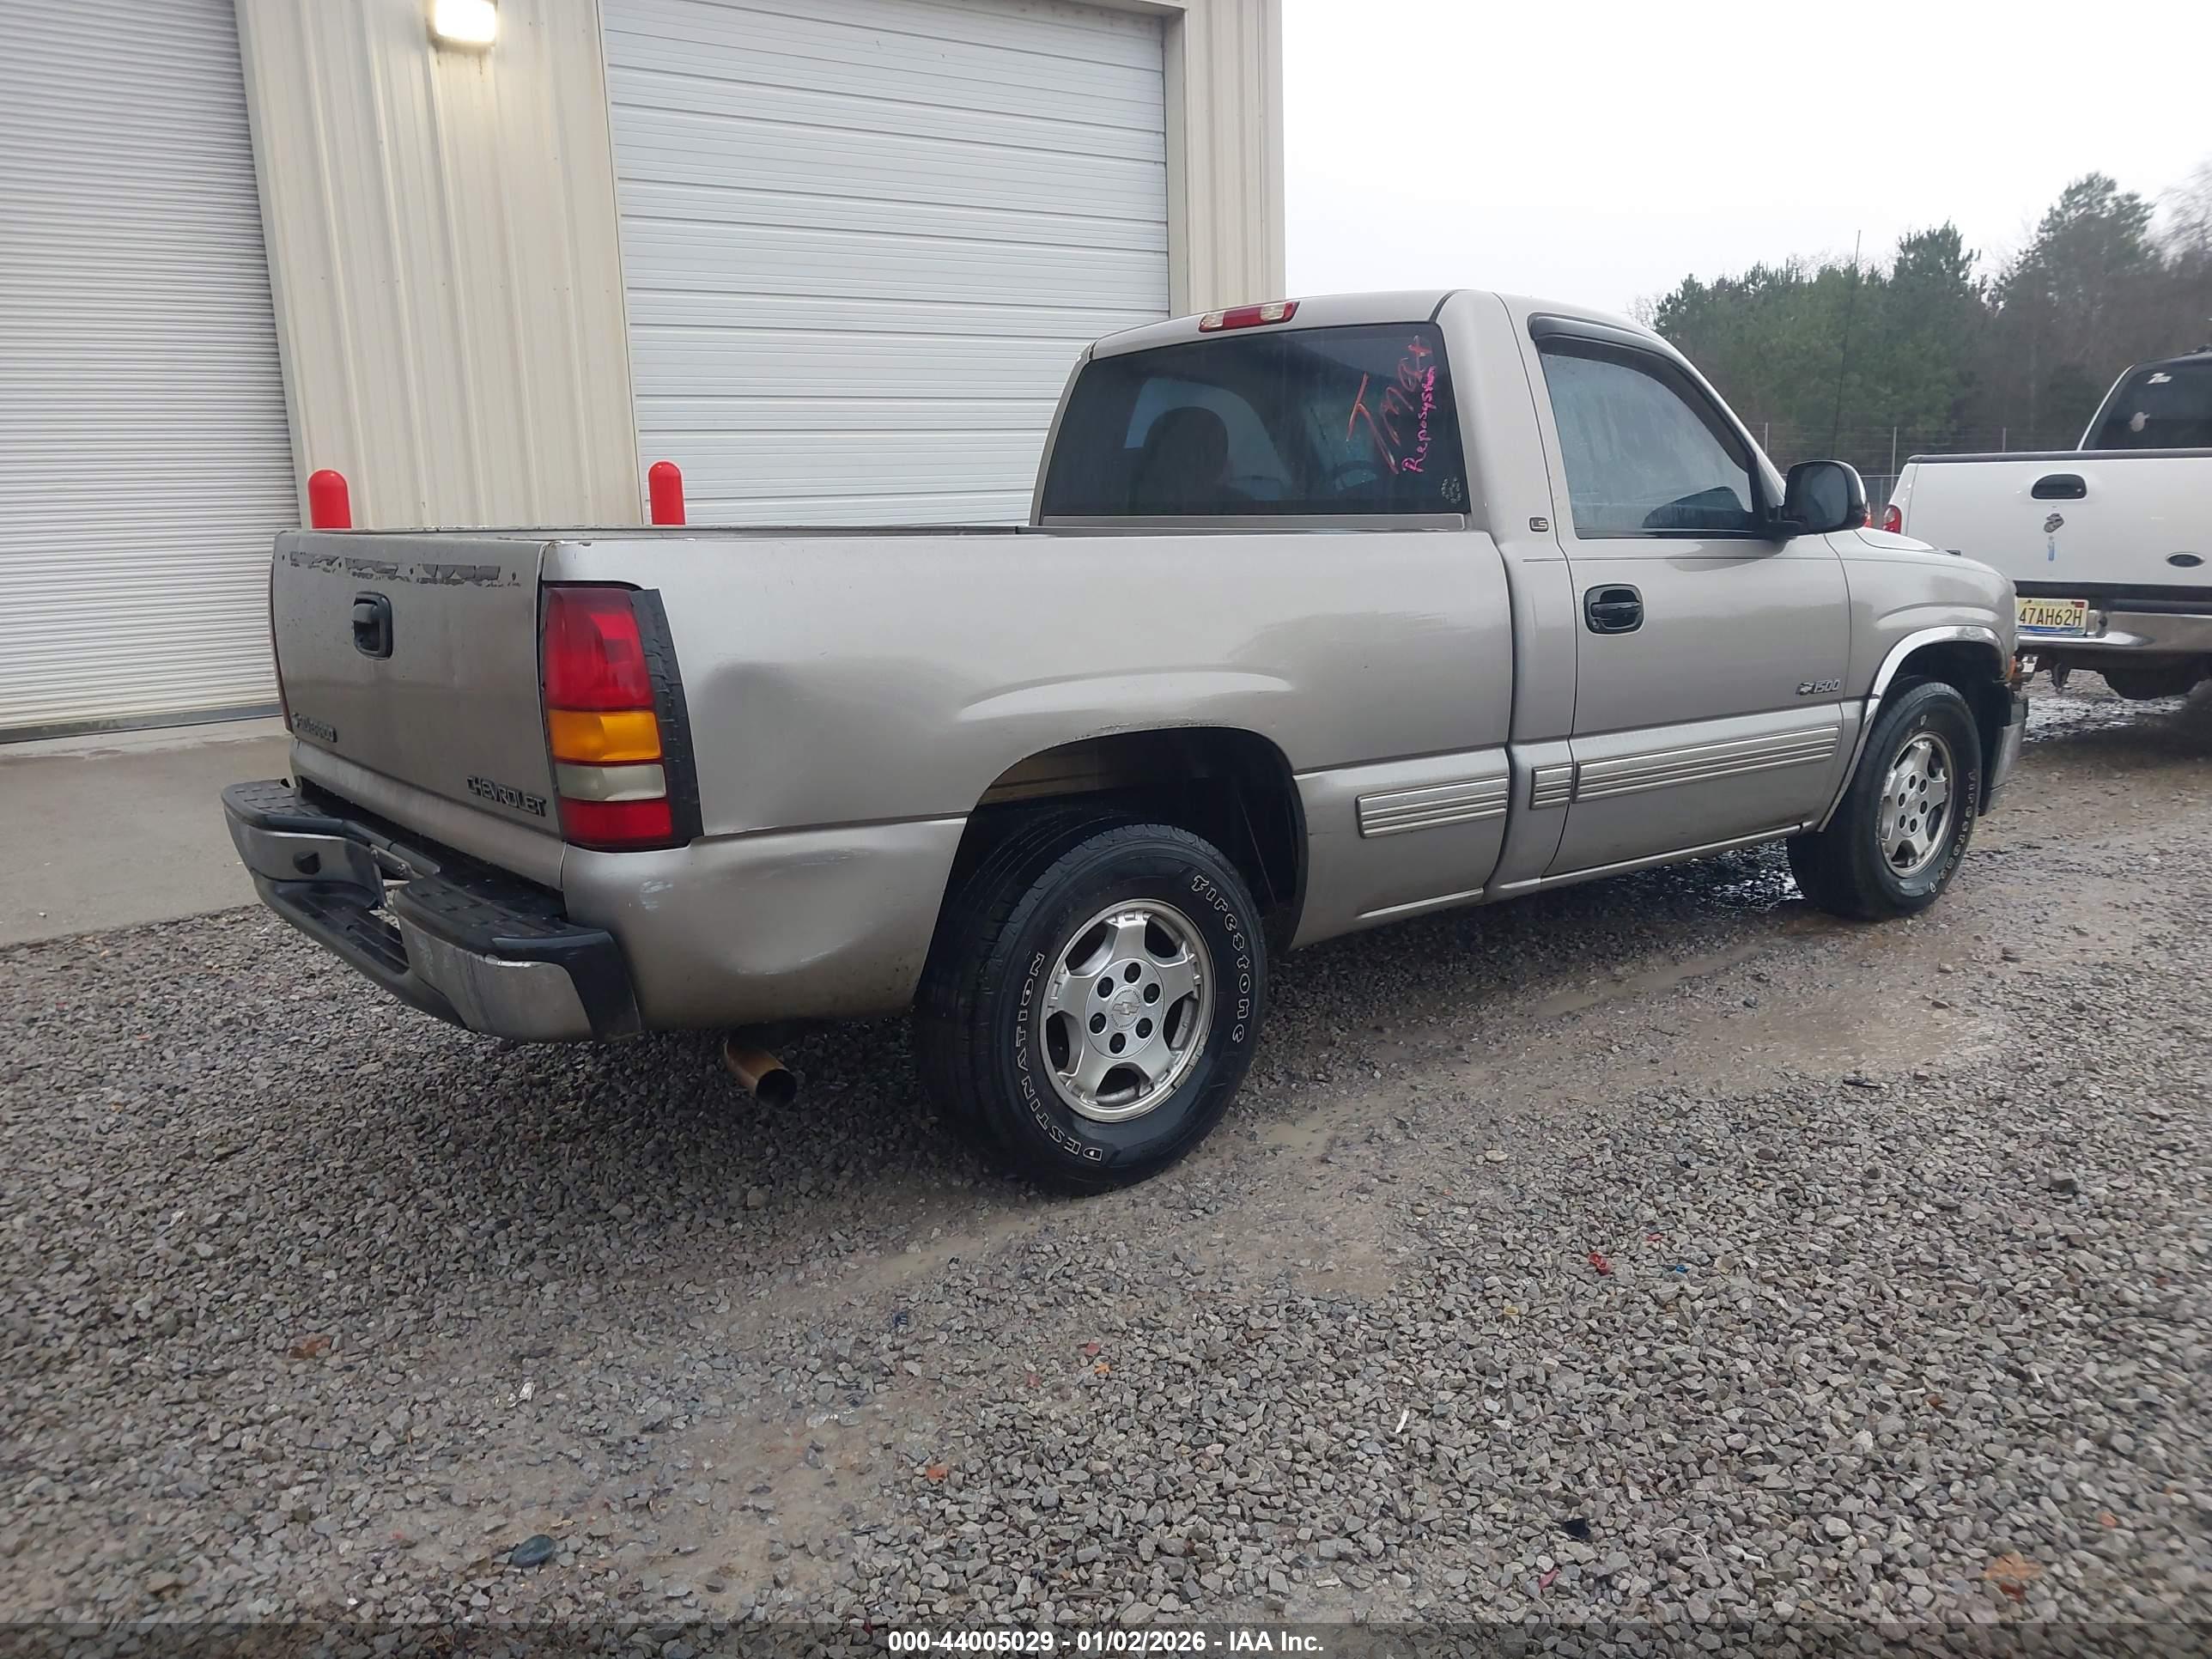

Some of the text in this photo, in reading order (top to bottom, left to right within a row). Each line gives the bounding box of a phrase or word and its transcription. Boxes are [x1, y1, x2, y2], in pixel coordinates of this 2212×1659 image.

[2019, 607, 2082, 627] 47AH62H
[1814, 679, 1841, 693] 1500
[466, 776, 547, 817] CHEVROLET
[1015, 951, 1103, 1162] DESTINATION
